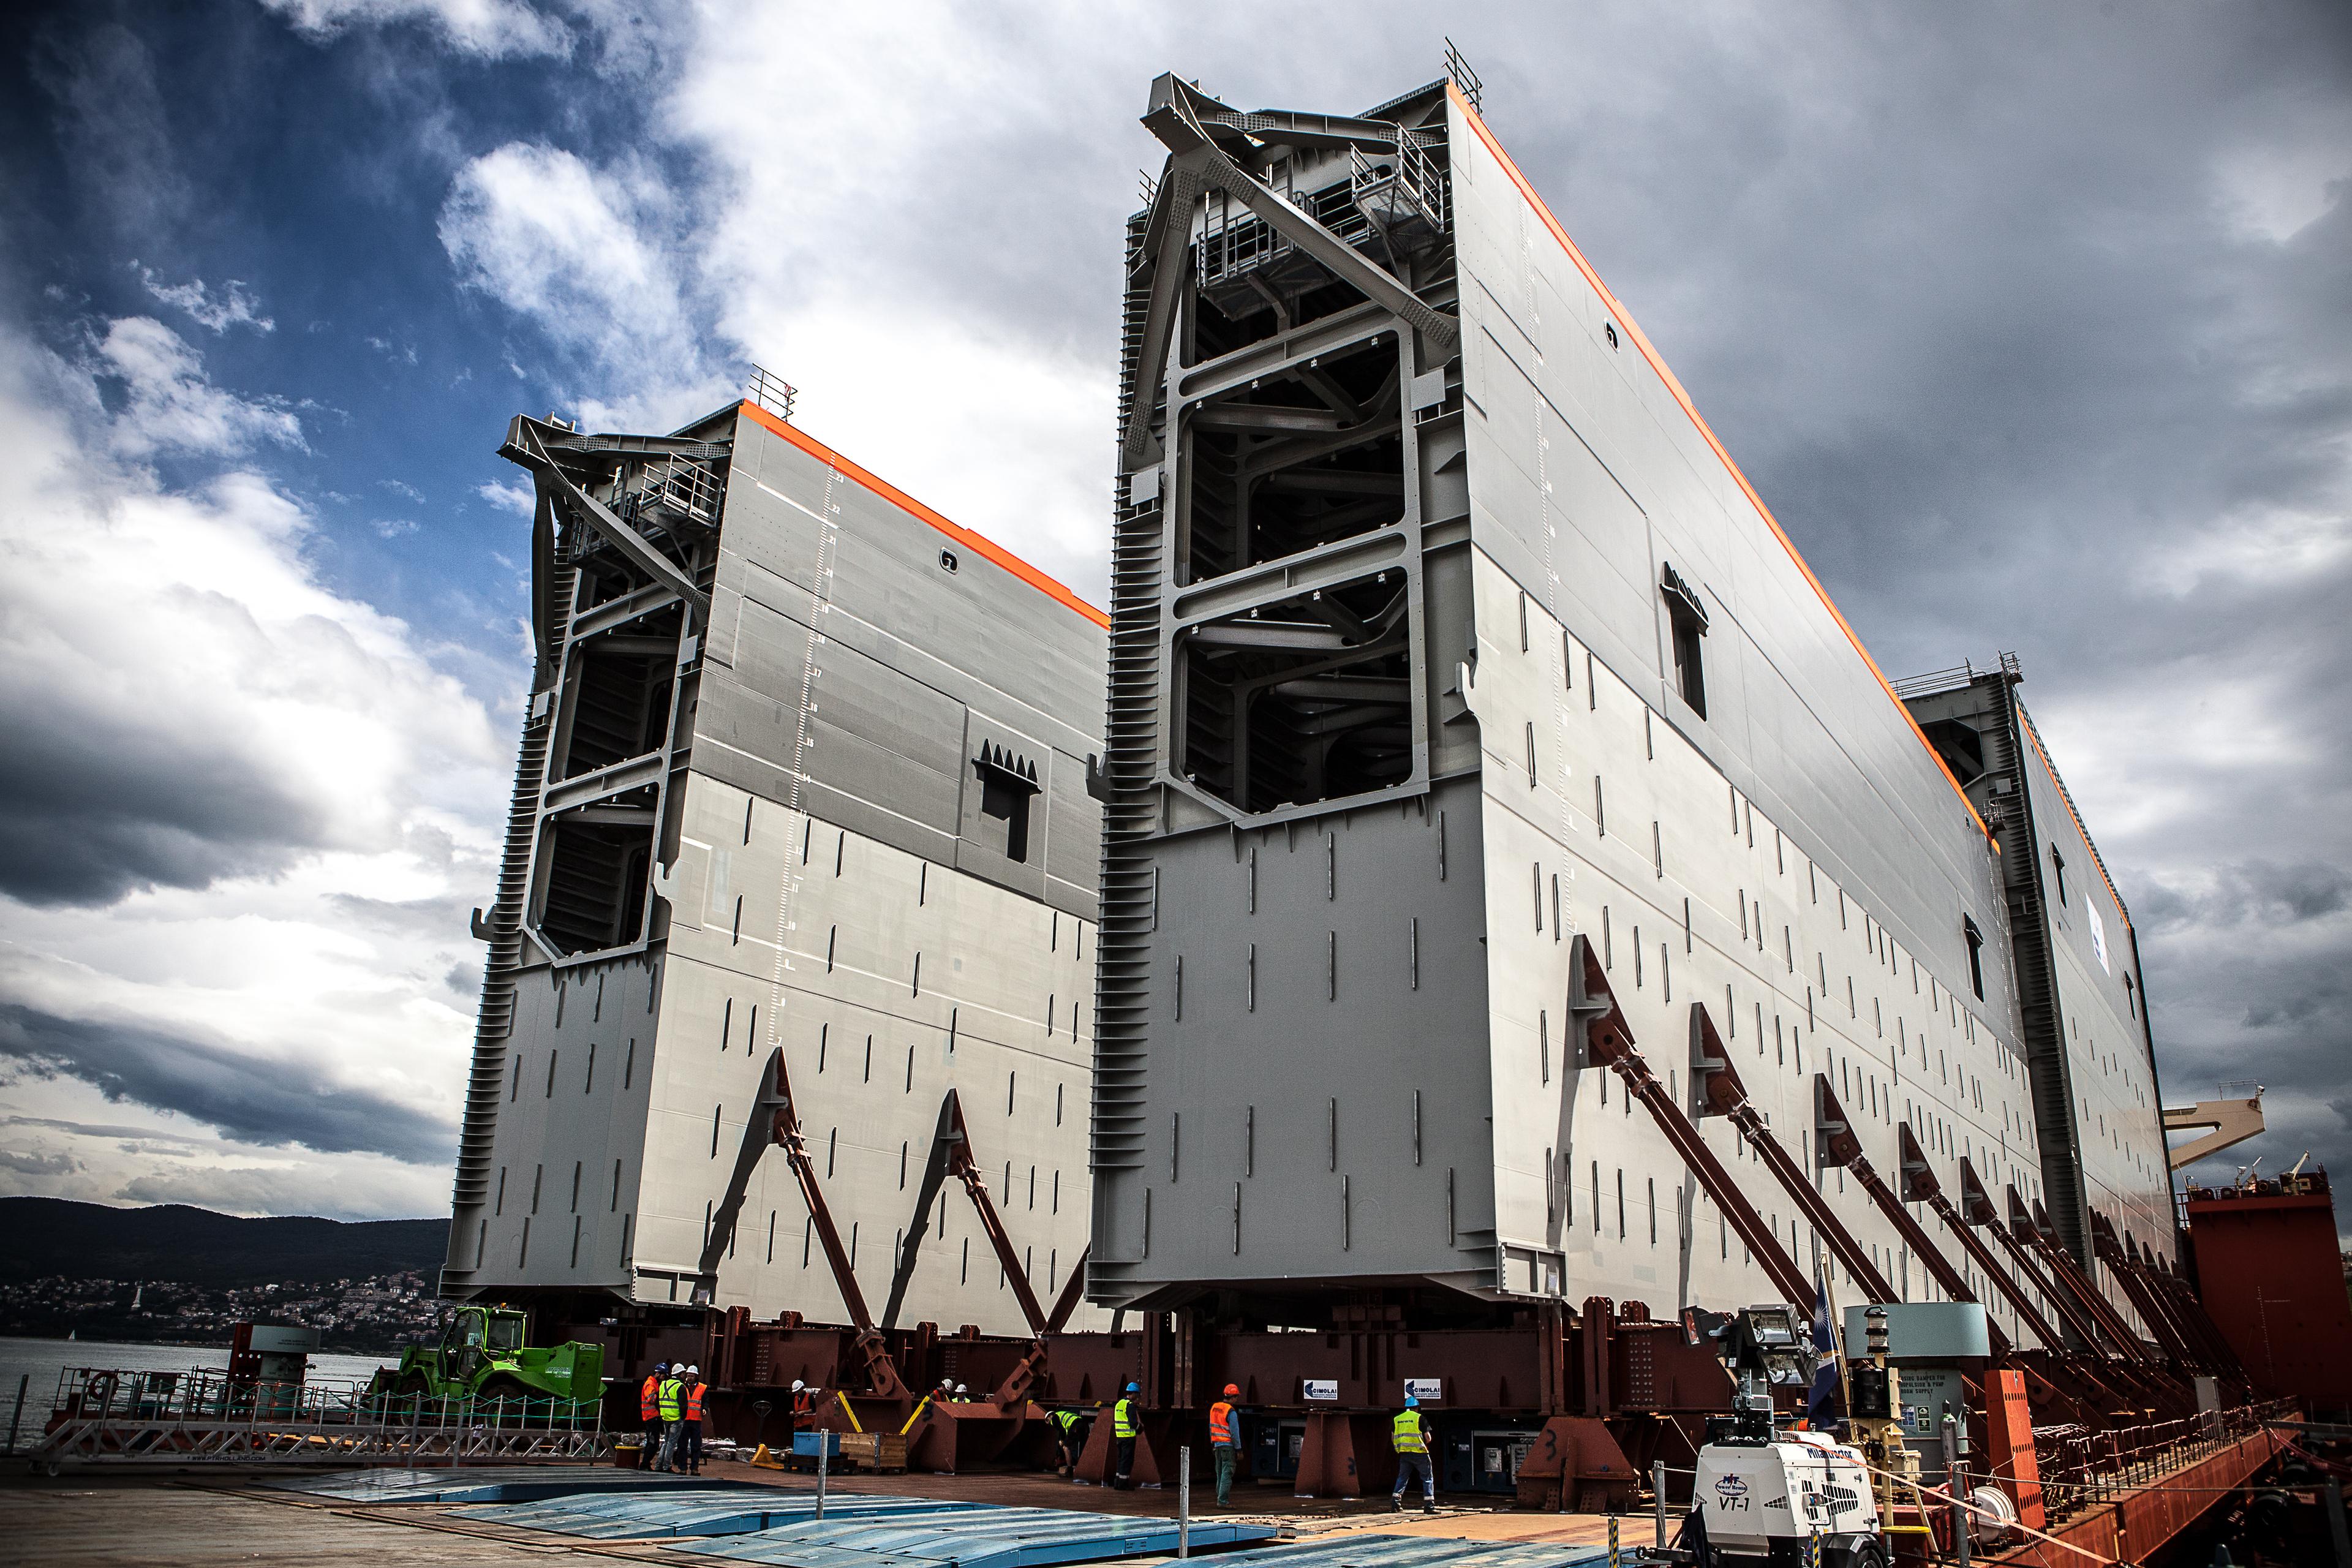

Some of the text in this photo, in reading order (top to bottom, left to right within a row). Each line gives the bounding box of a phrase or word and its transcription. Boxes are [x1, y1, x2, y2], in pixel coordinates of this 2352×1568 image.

[833, 505, 840, 514] 22
[830, 535, 836, 546] 21
[815, 668, 822, 678] 17
[810, 703, 818, 712] 16
[807, 737, 814, 747] 15
[803, 773, 811, 783] 14
[796, 846, 804, 856] 12
[792, 883, 799, 893] 11
[788, 921, 796, 931] 10
[781, 997, 786, 1007] 8
[777, 1036, 782, 1046] 7
[1545, 1428, 1556, 1461] 3
[1719, 1496, 1749, 1512] VT-1
